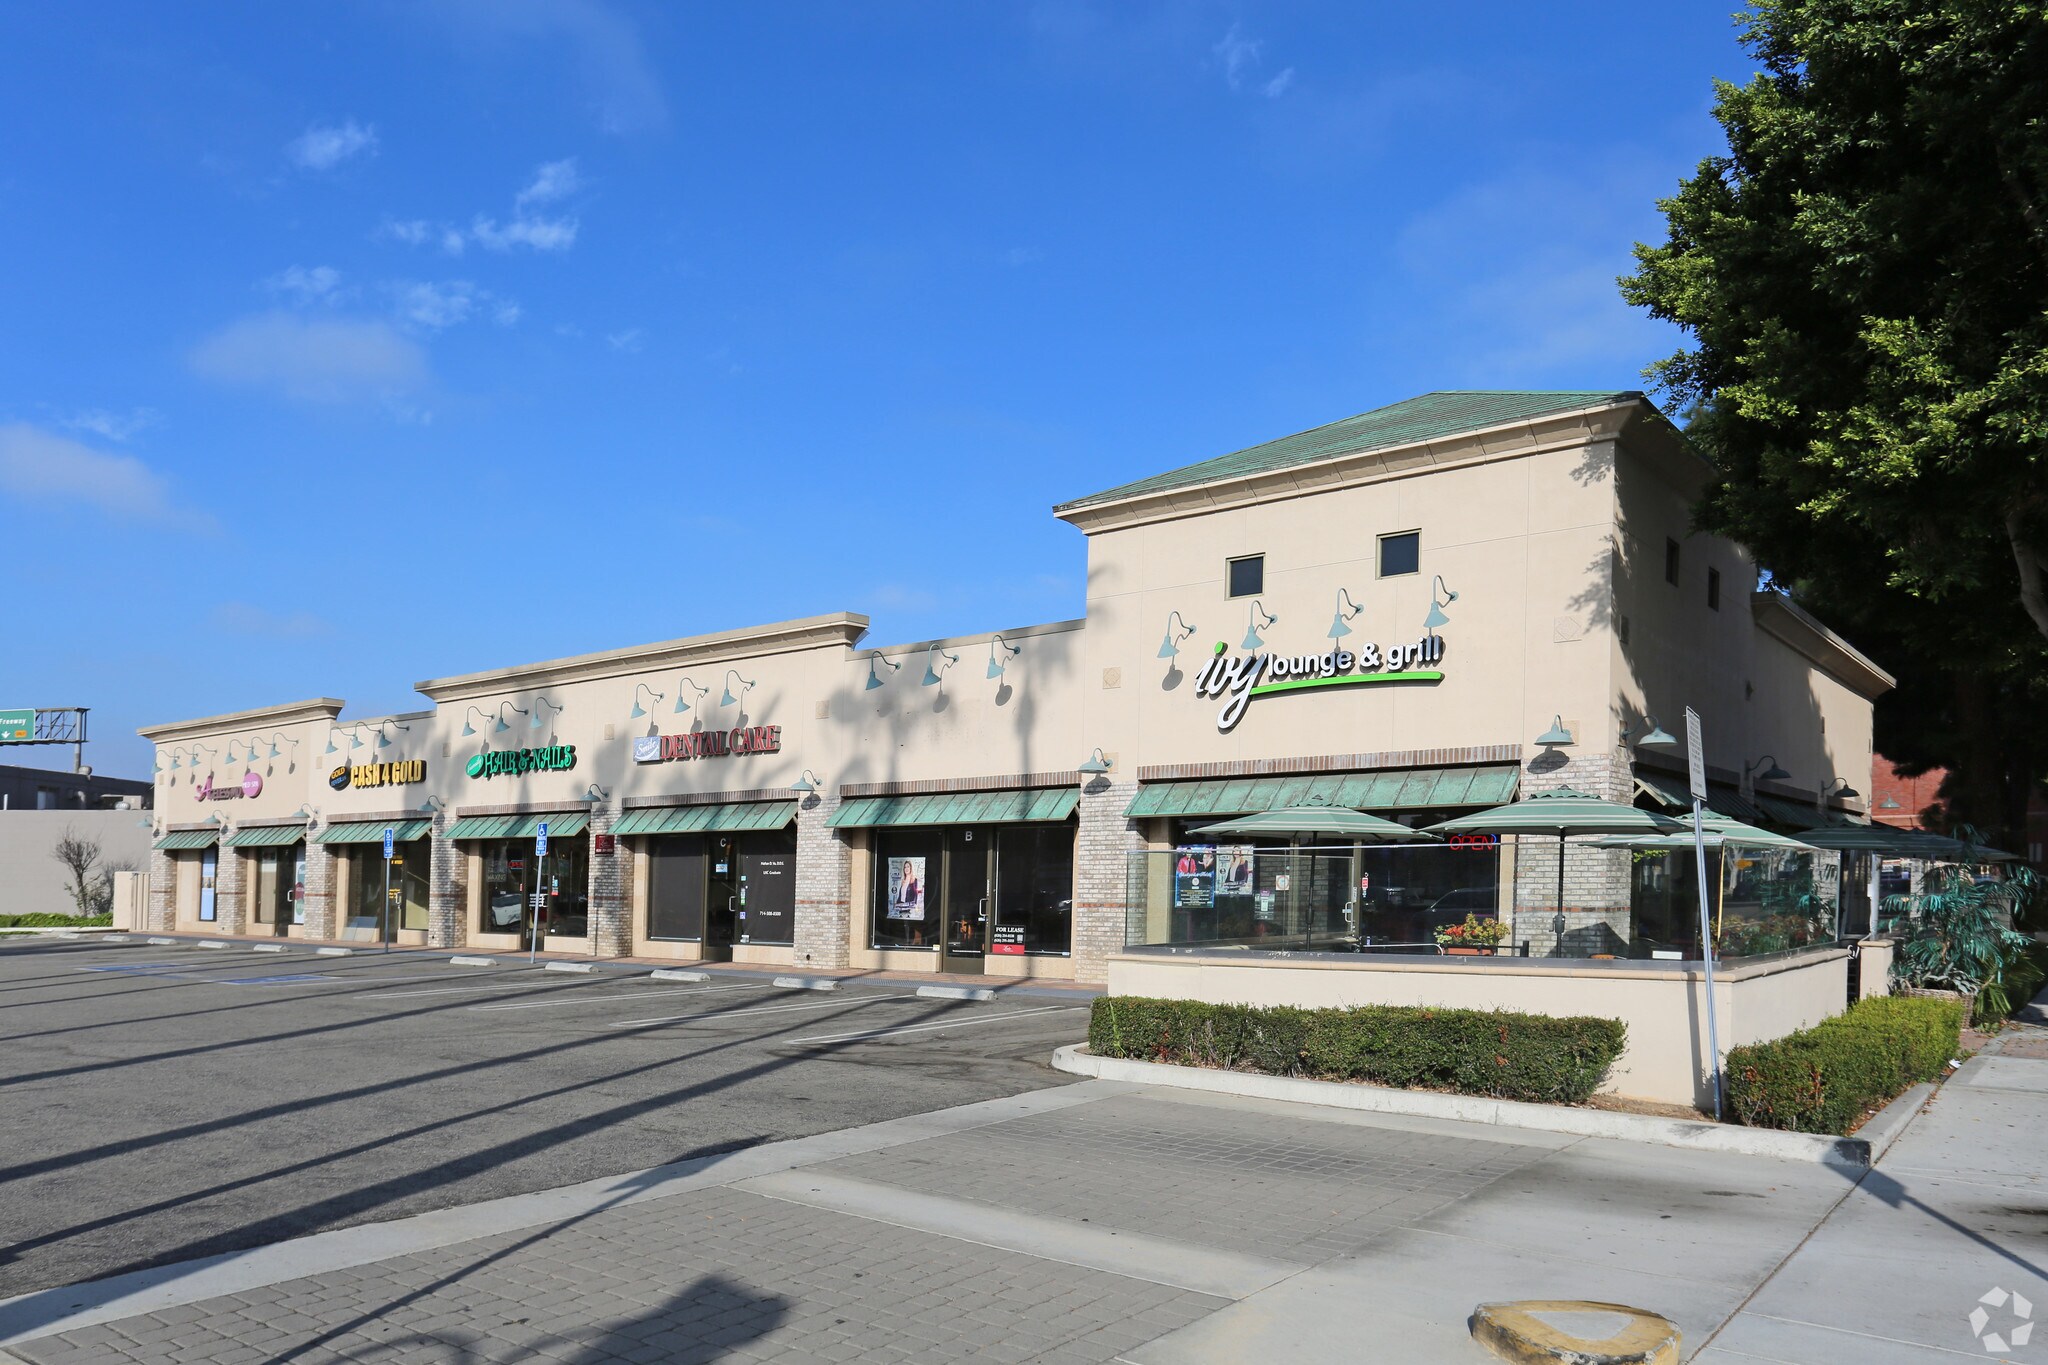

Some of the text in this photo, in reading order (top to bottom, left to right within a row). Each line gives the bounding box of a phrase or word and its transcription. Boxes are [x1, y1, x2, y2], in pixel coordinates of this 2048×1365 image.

[1195, 635, 1441, 729] ivy lounge & grill
[660, 725, 778, 759] DENTAL CARE
[350, 759, 423, 787] CASH 4 GOLD
[483, 751, 518, 777] HAIR
[518, 748, 531, 771] &
[530, 744, 573, 769] NAILS
[719, 837, 727, 848] C
[964, 830, 974, 842] B
[1449, 834, 1495, 851] OPEN
